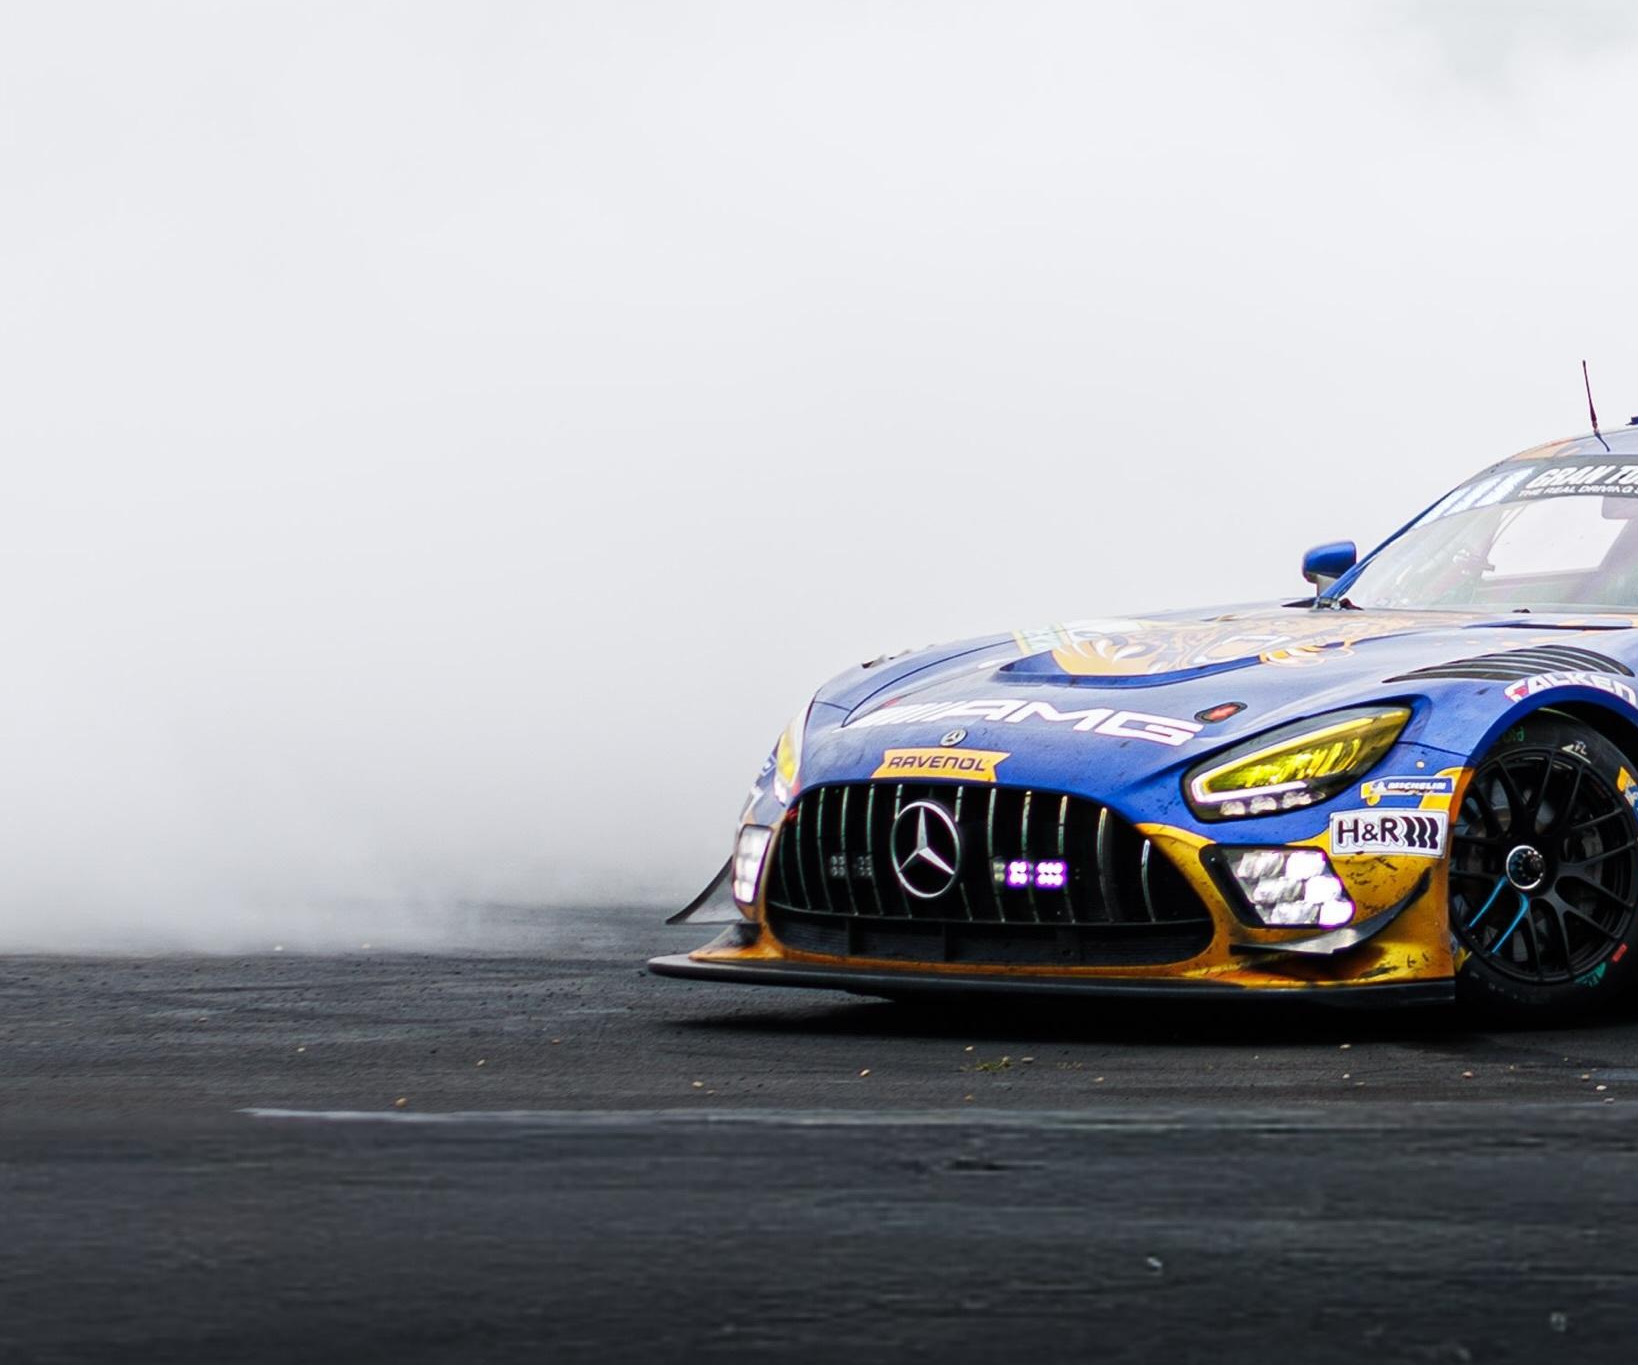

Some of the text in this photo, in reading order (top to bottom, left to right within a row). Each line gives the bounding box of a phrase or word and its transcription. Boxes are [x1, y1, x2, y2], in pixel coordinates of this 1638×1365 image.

[1527, 464, 1616, 488] GRAN
[1517, 487, 1543, 497] THE
[1544, 486, 1577, 495] REAL
[1504, 671, 1637, 706] FALKEN
[937, 700, 1204, 746] AMG
[887, 755, 988, 772] RAVENOL
[1387, 781, 1447, 791] MICHELIN
[1337, 818, 1401, 846] H&R
